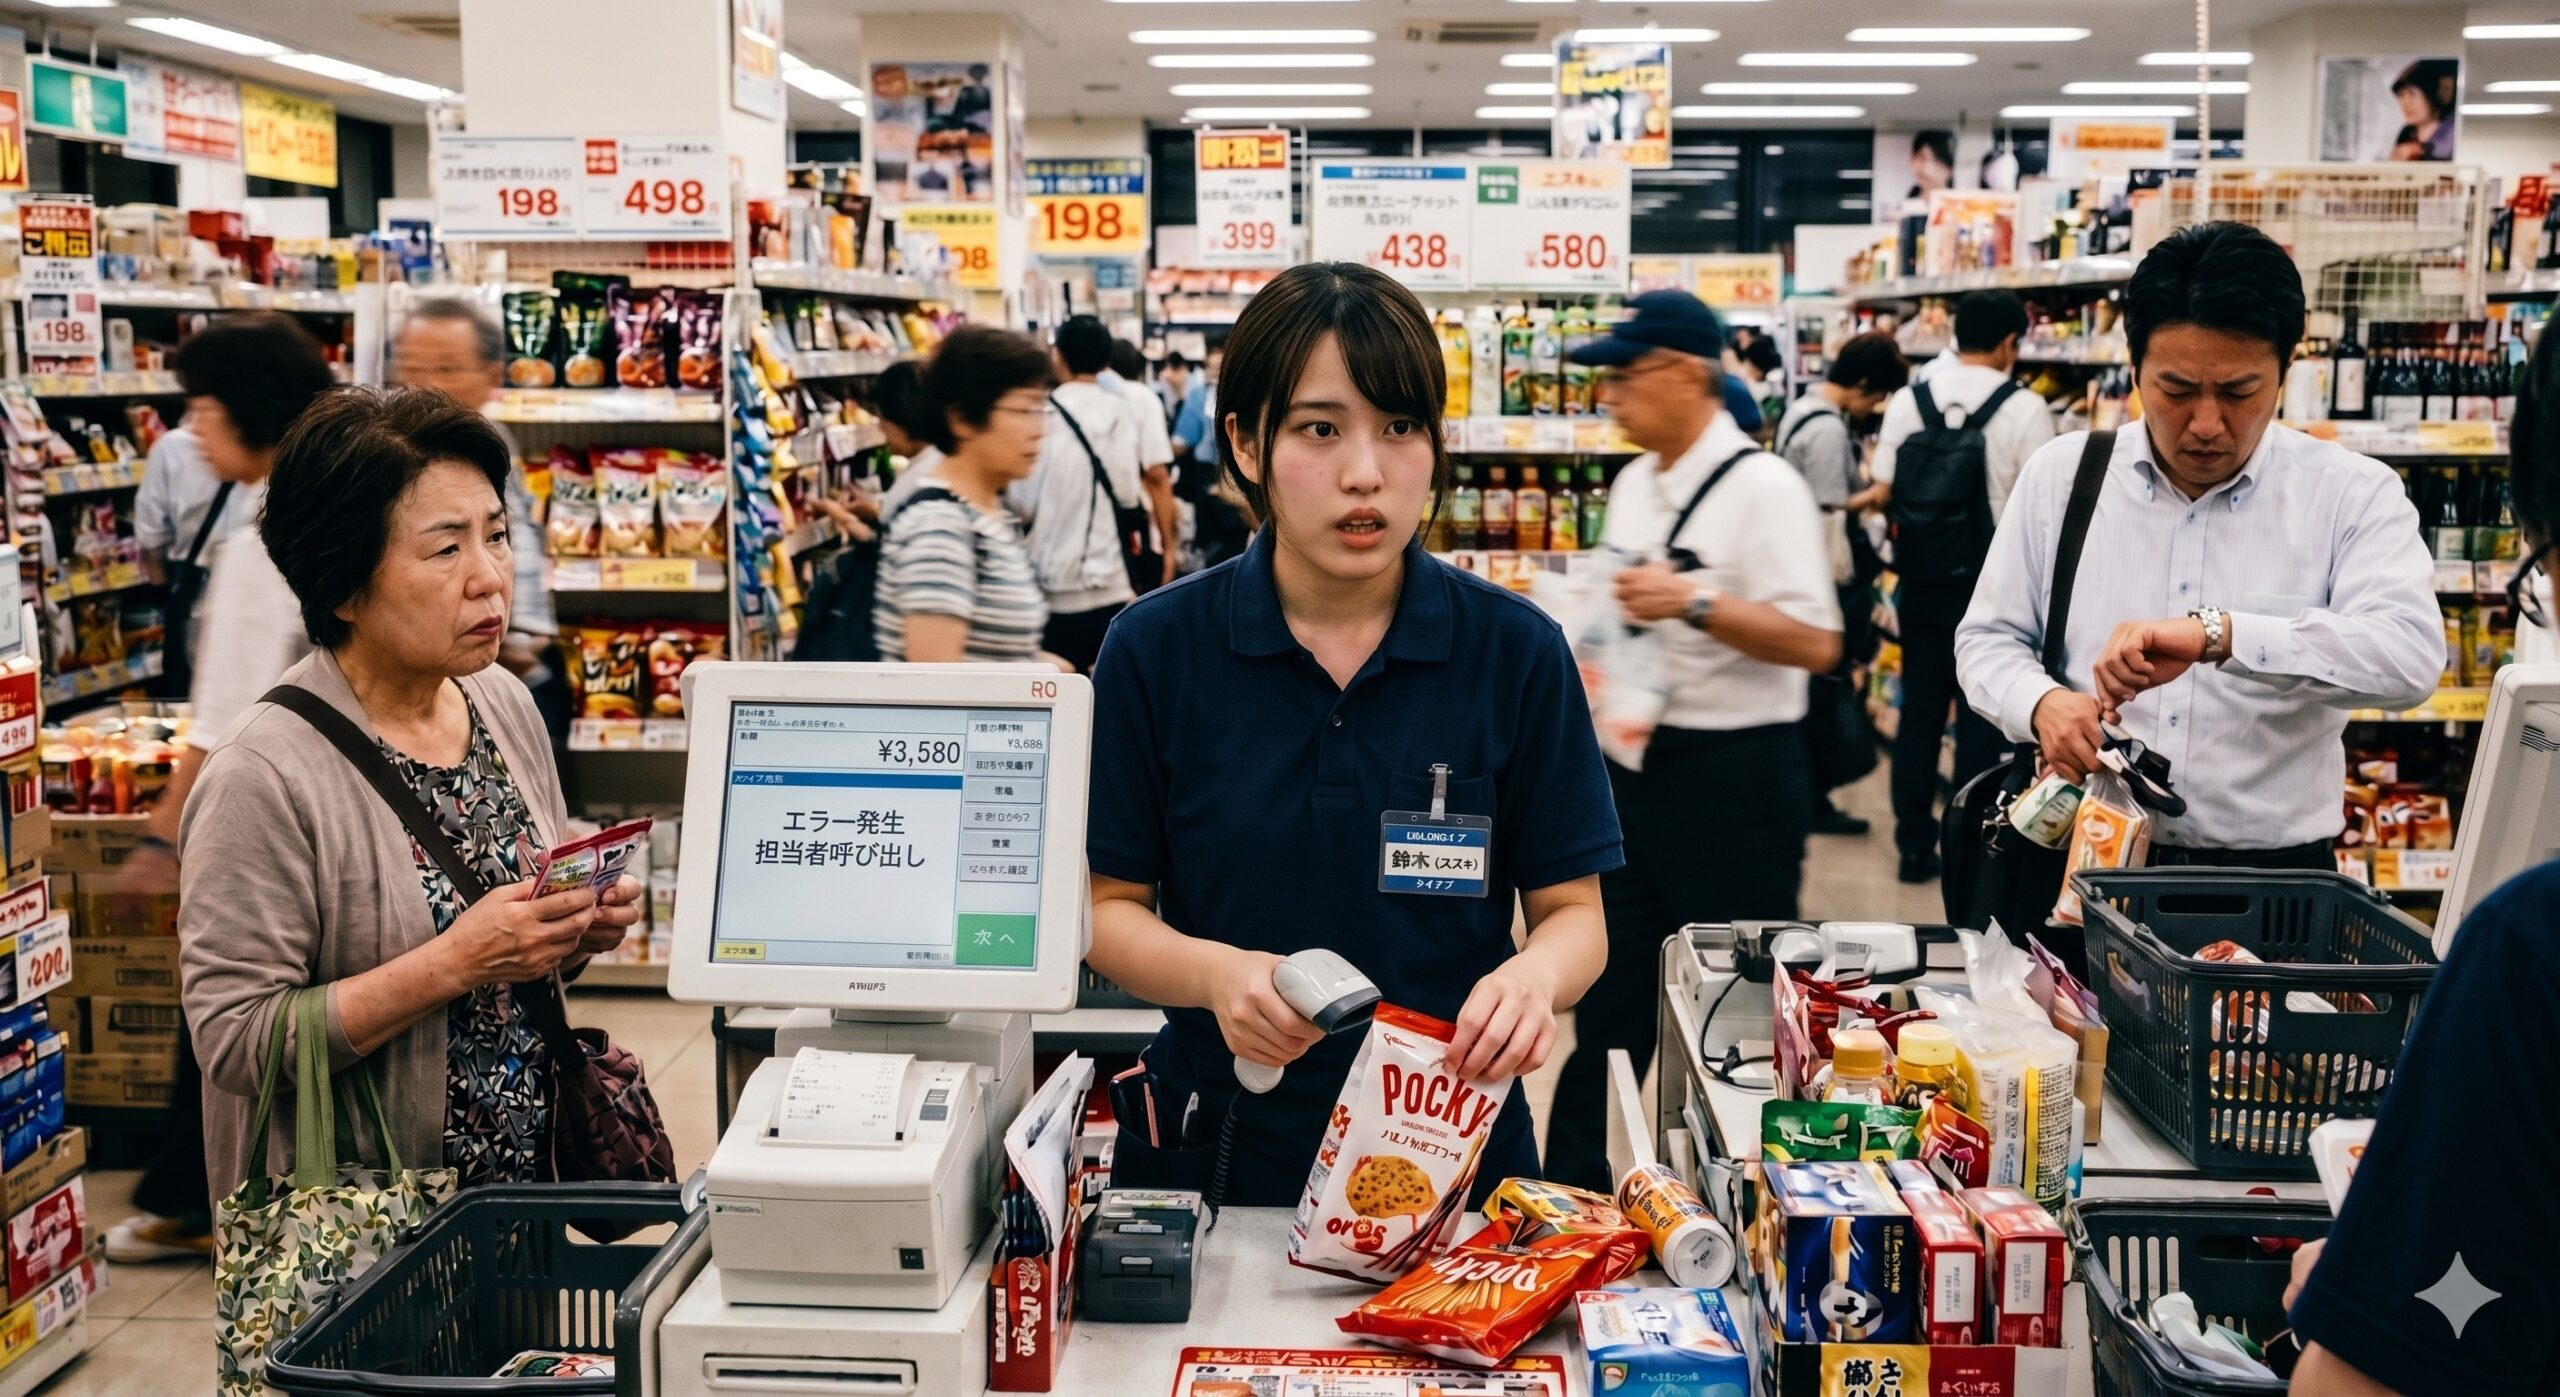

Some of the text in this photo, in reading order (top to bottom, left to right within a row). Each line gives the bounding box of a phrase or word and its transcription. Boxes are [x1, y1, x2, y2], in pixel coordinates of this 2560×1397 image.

[498, 188, 558, 216] 198
[624, 180, 705, 215] 498
[1045, 202, 1121, 240] 198
[44, 321, 85, 342] 198
[878, 740, 961, 767] ¥3,580
[783, 809, 905, 835] エラー発生
[755, 839, 926, 868] 担当者呼び出し
[1392, 849, 1430, 869] 鈴木
